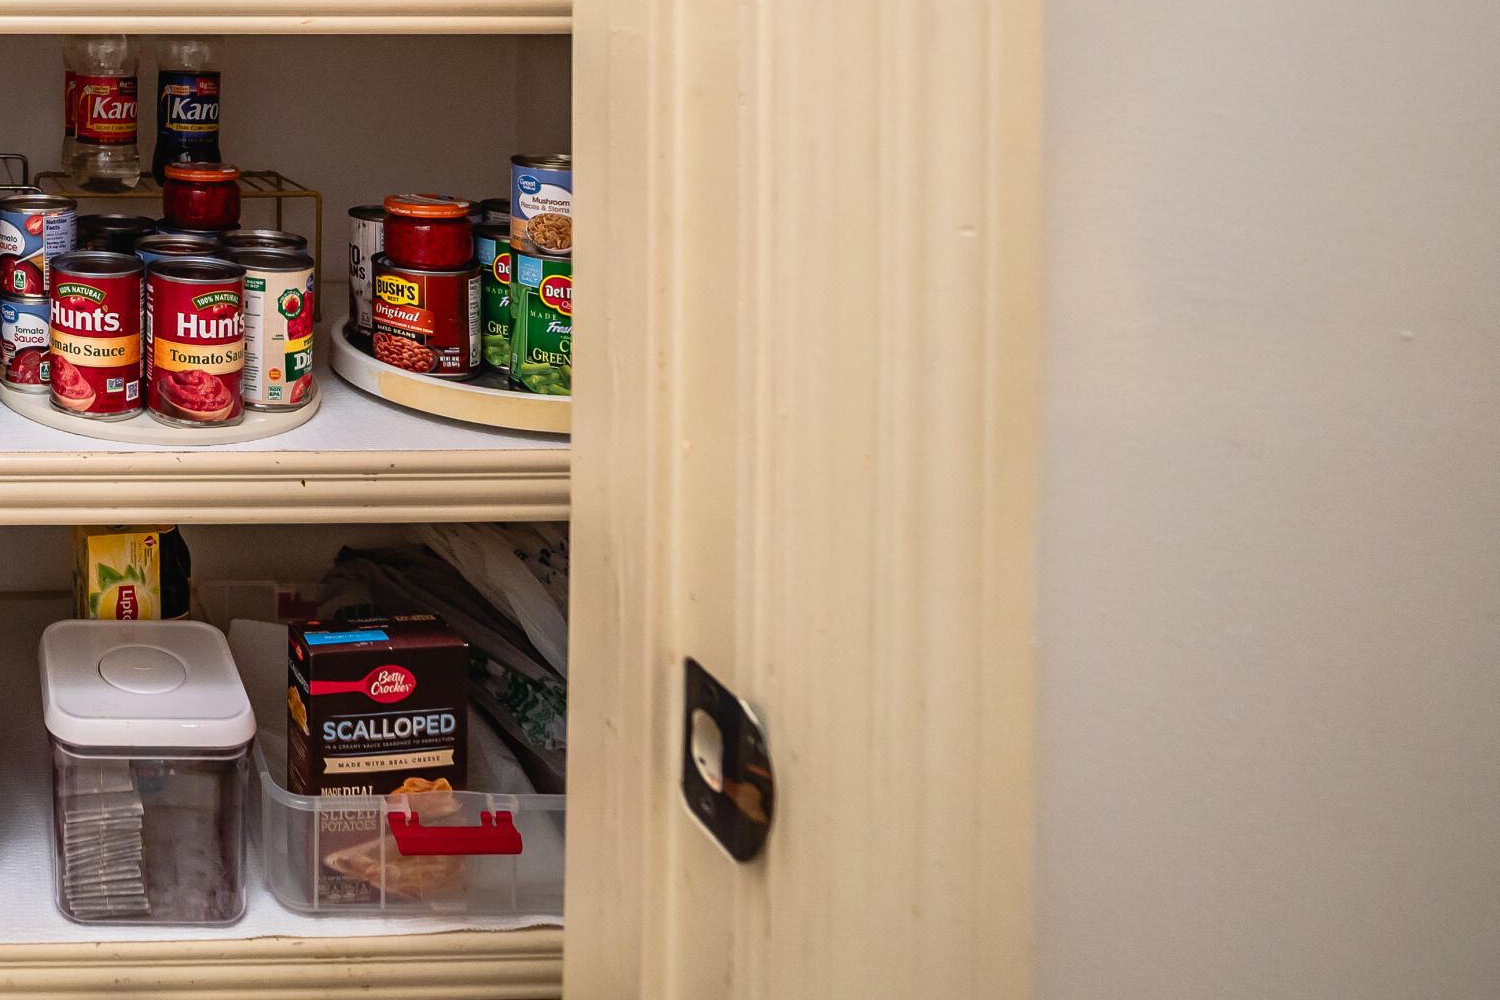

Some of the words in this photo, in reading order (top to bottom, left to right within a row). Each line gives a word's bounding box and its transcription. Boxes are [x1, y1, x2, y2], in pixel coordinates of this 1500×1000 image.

[92, 97, 137, 119] Karo
[172, 97, 219, 120] Karo
[520, 179, 536, 187] Great
[532, 196, 570, 206] Mushroom
[521, 201, 539, 211] Pieces
[548, 206, 570, 214] Stems
[522, 276, 538, 284] SALT
[523, 270, 536, 278] SEA
[72, 286, 102, 300] NATURAL
[377, 277, 415, 301] BUSH'S
[486, 286, 508, 296] MADE
[546, 285, 564, 299] Del
[197, 295, 213, 306] 100%
[376, 303, 420, 322] Original
[531, 310, 557, 321] MADE
[14, 326, 44, 335] Tomato
[393, 328, 416, 339] BEANS
[14, 333, 44, 344] Sauce
[84, 344, 125, 357] Sauce
[170, 349, 223, 365] Tomato
[378, 670, 405, 685] Betty
[370, 682, 409, 696] Crocker
[323, 713, 455, 741] SCALLOPED
[389, 758, 408, 766] REAL
[321, 786, 341, 797] MADE
[321, 820, 376, 832] POTATOES
